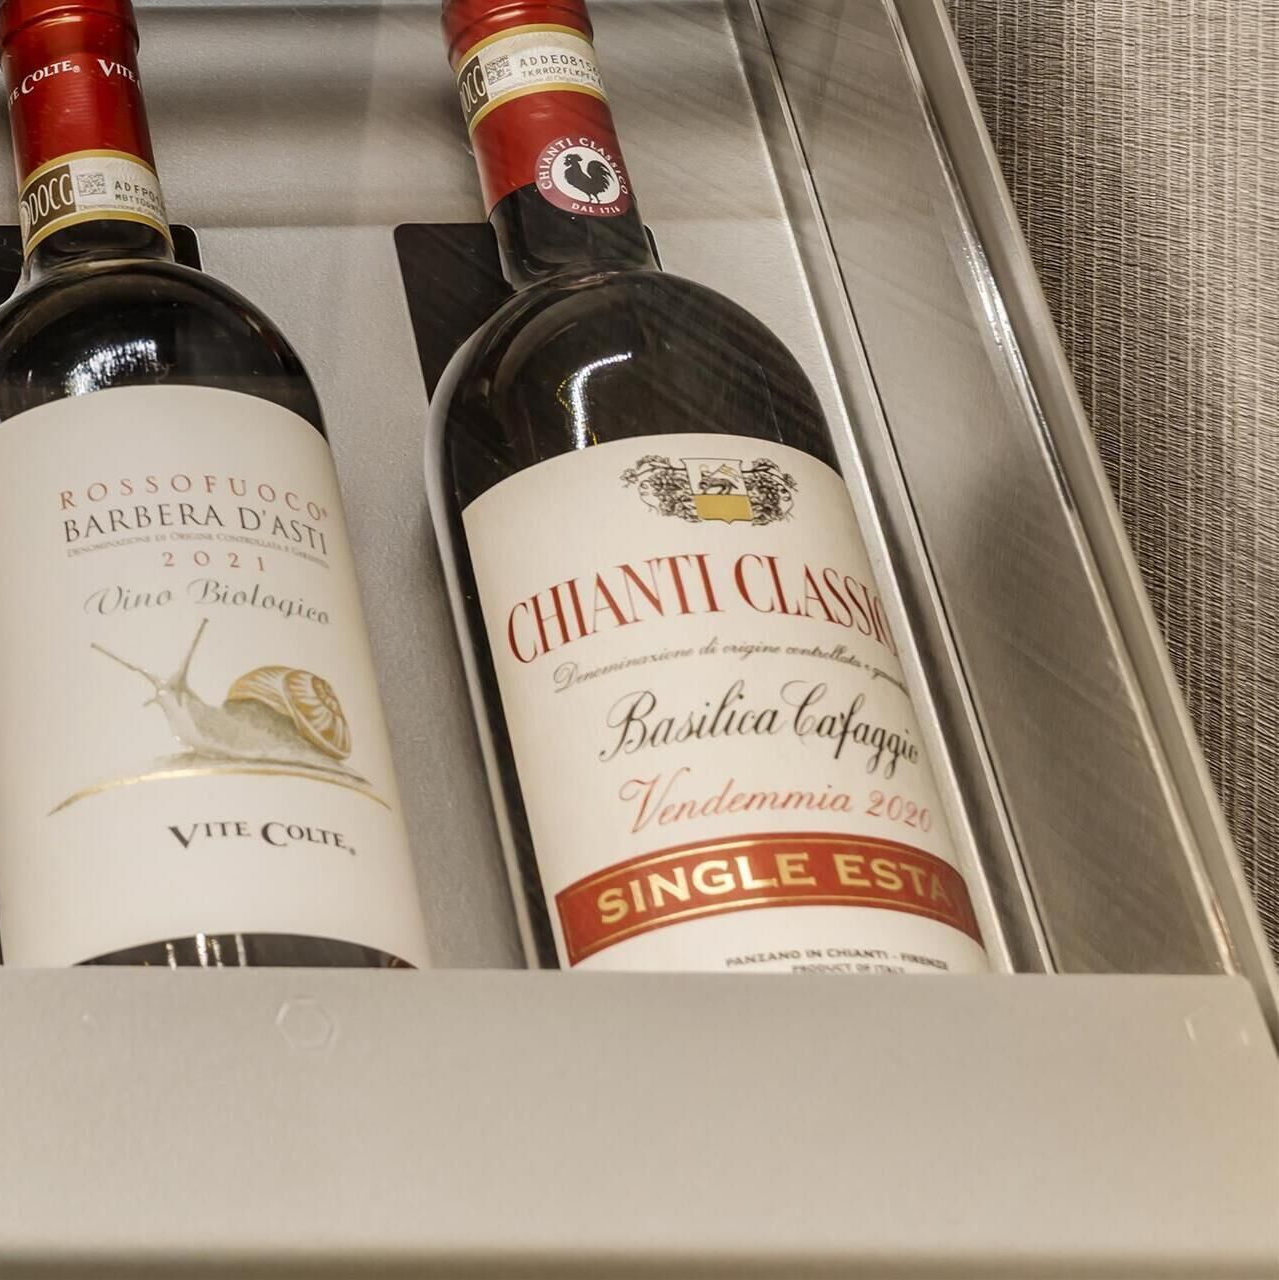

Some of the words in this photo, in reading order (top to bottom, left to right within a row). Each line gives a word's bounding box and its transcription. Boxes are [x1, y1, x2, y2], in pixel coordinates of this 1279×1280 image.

[98, 59, 136, 83] VITE
[538, 137, 574, 190] CHIANTI
[571, 202, 595, 213] DAL
[63, 503, 225, 544] BARBERA
[237, 505, 328, 556] D'ASTI
[83, 585, 173, 615] Vino
[186, 577, 331, 625] Biologico
[506, 553, 724, 665] CHIANTI
[598, 678, 780, 764] Basilica
[618, 767, 853, 835] Vendemmia
[867, 788, 933, 833] 2020
[167, 821, 251, 849] VITE
[261, 821, 347, 850] COLTE
[595, 852, 818, 925] SINGLE
